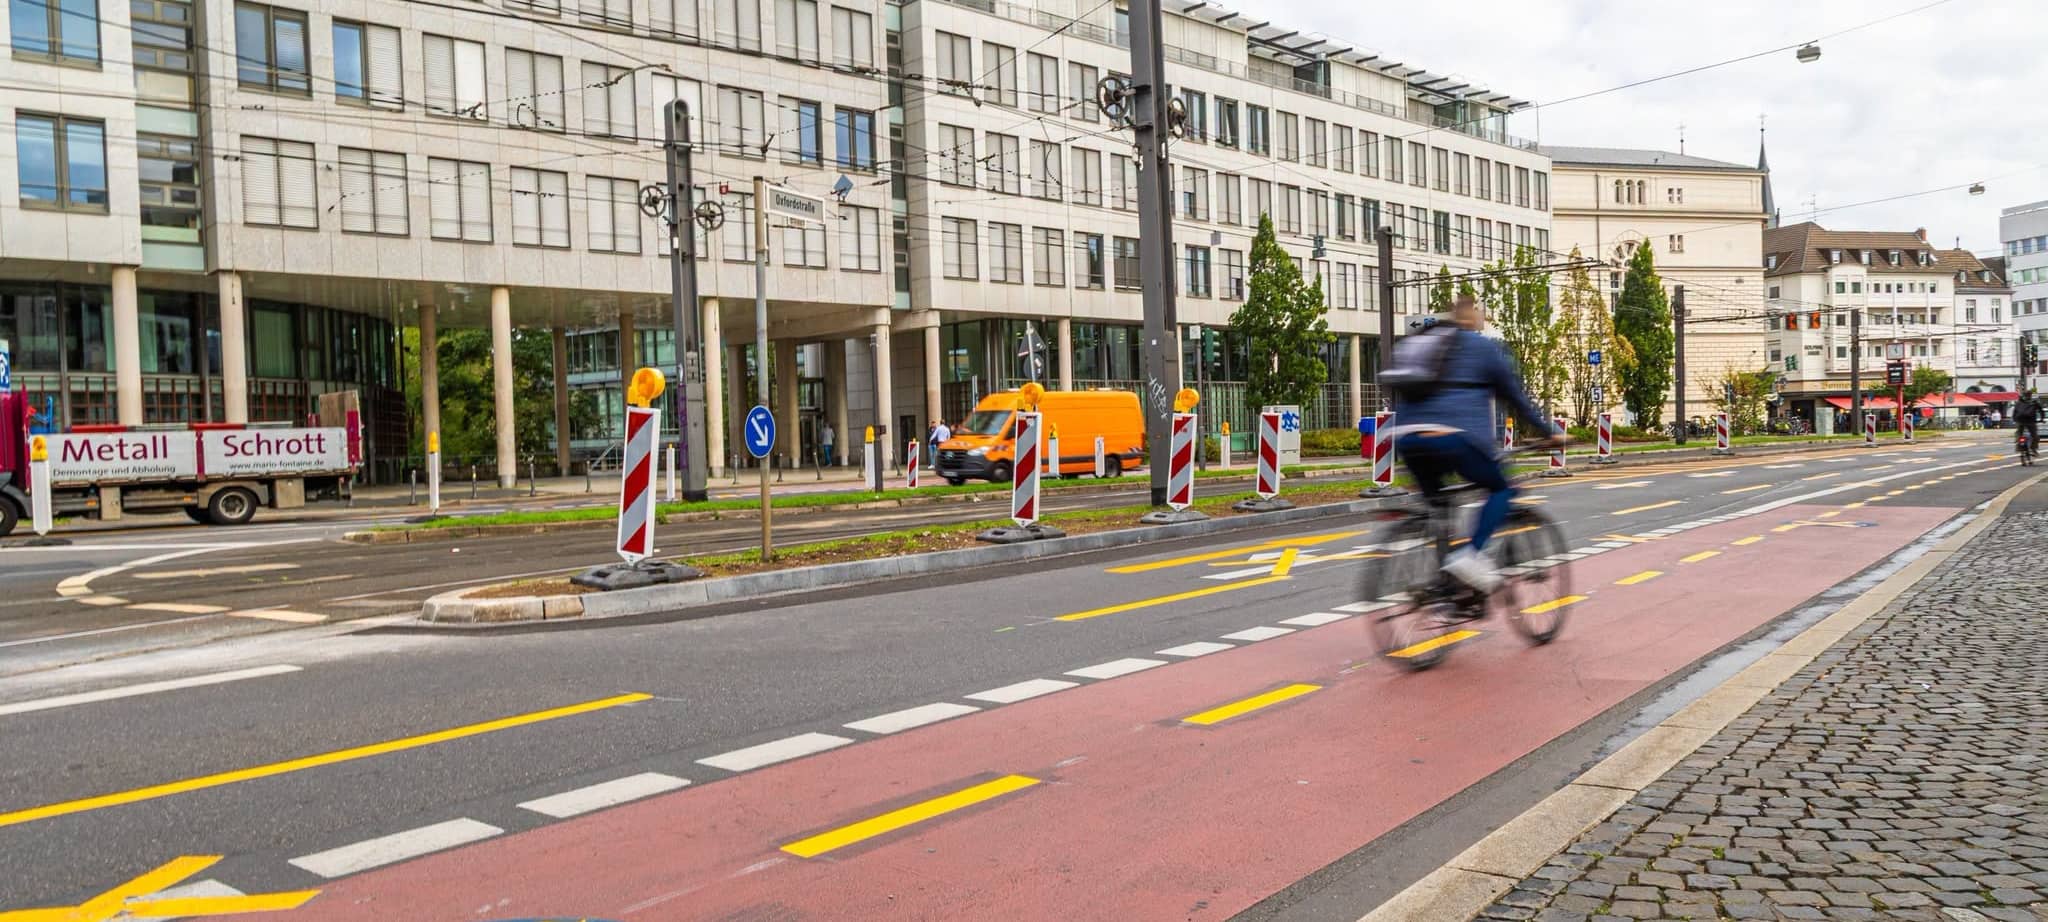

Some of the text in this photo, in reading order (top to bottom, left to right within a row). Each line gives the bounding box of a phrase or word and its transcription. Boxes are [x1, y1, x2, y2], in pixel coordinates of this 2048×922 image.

[776, 193, 815, 214] Oxfordstraße
[1593, 388, 1600, 401] 5
[62, 435, 168, 462] Metall
[223, 432, 327, 457] Schrott
[53, 464, 176, 477] Demontage und Abholung
